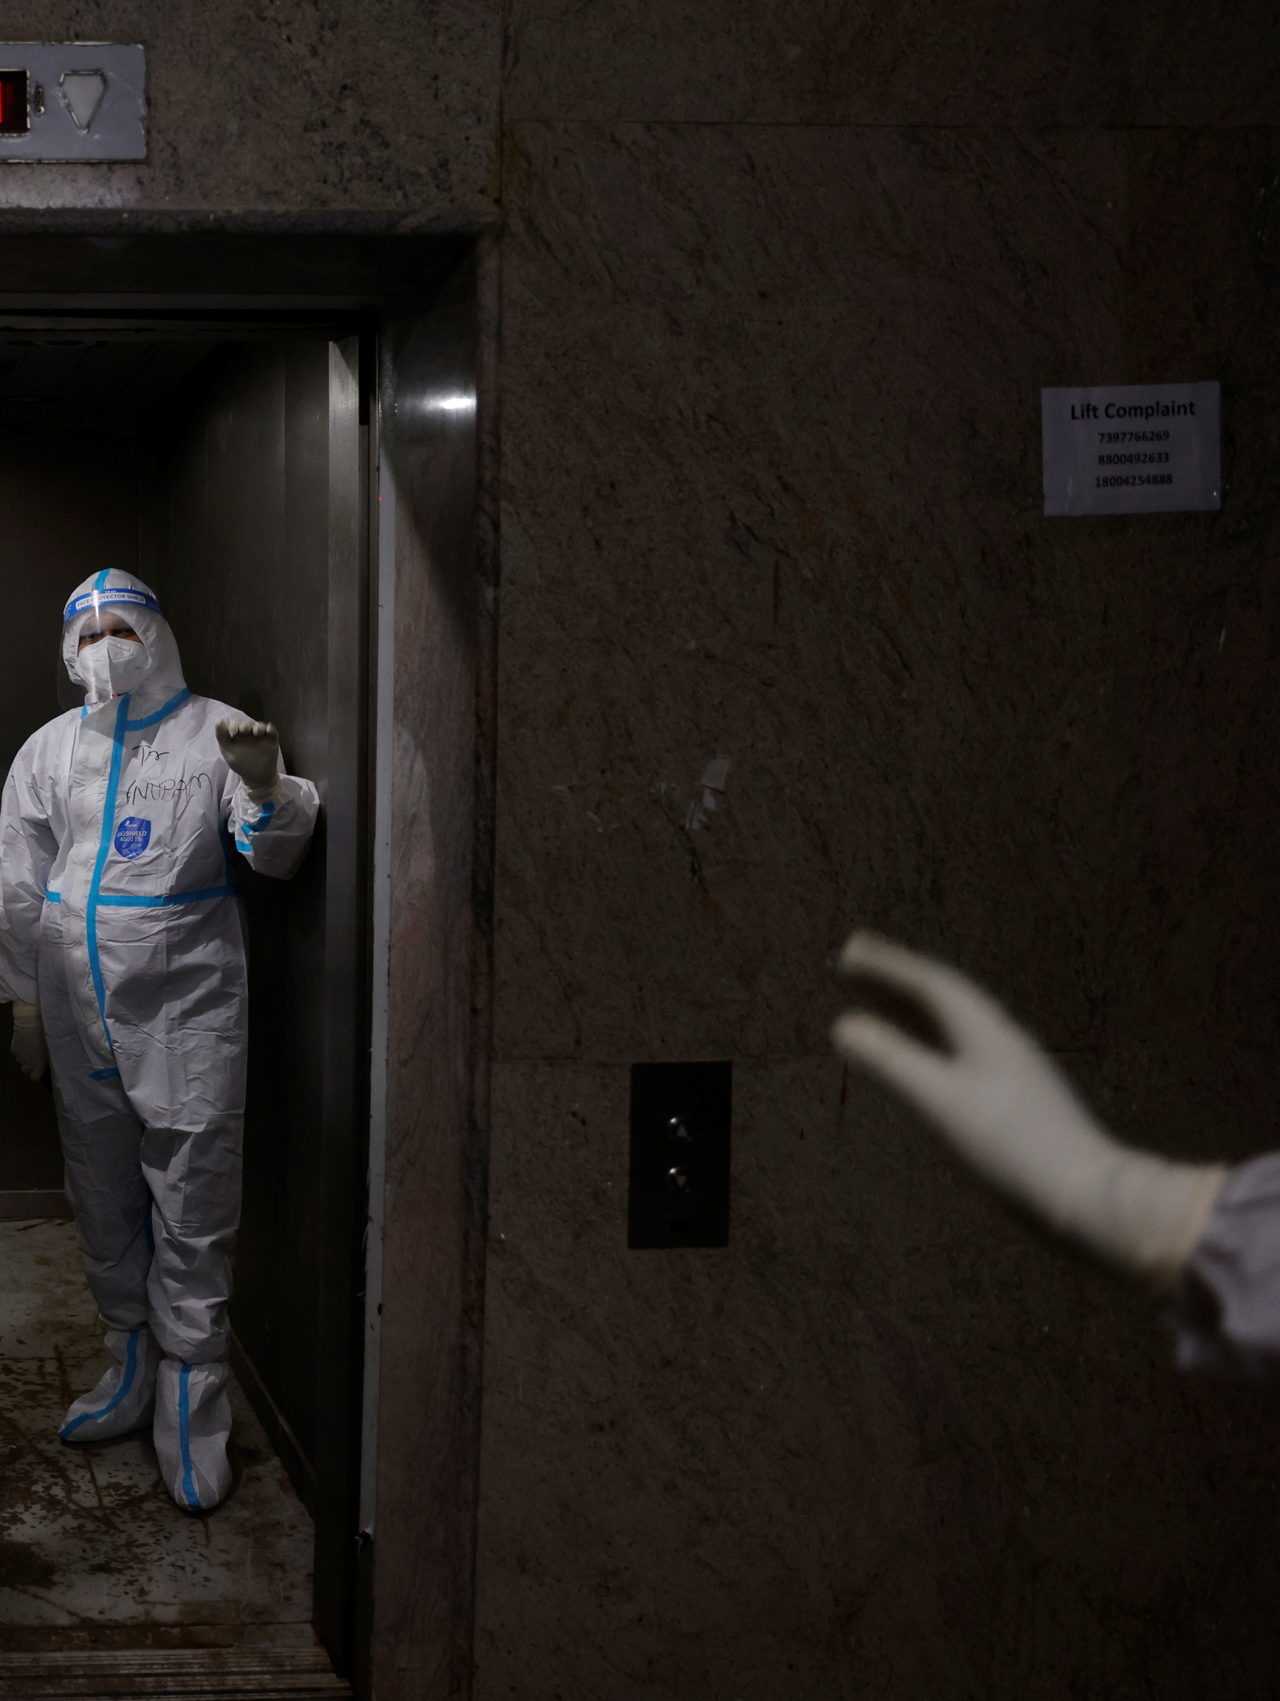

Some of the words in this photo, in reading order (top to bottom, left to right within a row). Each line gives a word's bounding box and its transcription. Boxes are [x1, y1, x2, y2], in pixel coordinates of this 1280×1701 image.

[1071, 403, 1099, 420] Lift
[1104, 401, 1195, 420] Complaint
[1098, 431, 1170, 443] 7397766269
[1098, 453, 1169, 465] 8800492633
[1095, 474, 1173, 487] 18004254888
[90, 593, 125, 603] POTECTOR
